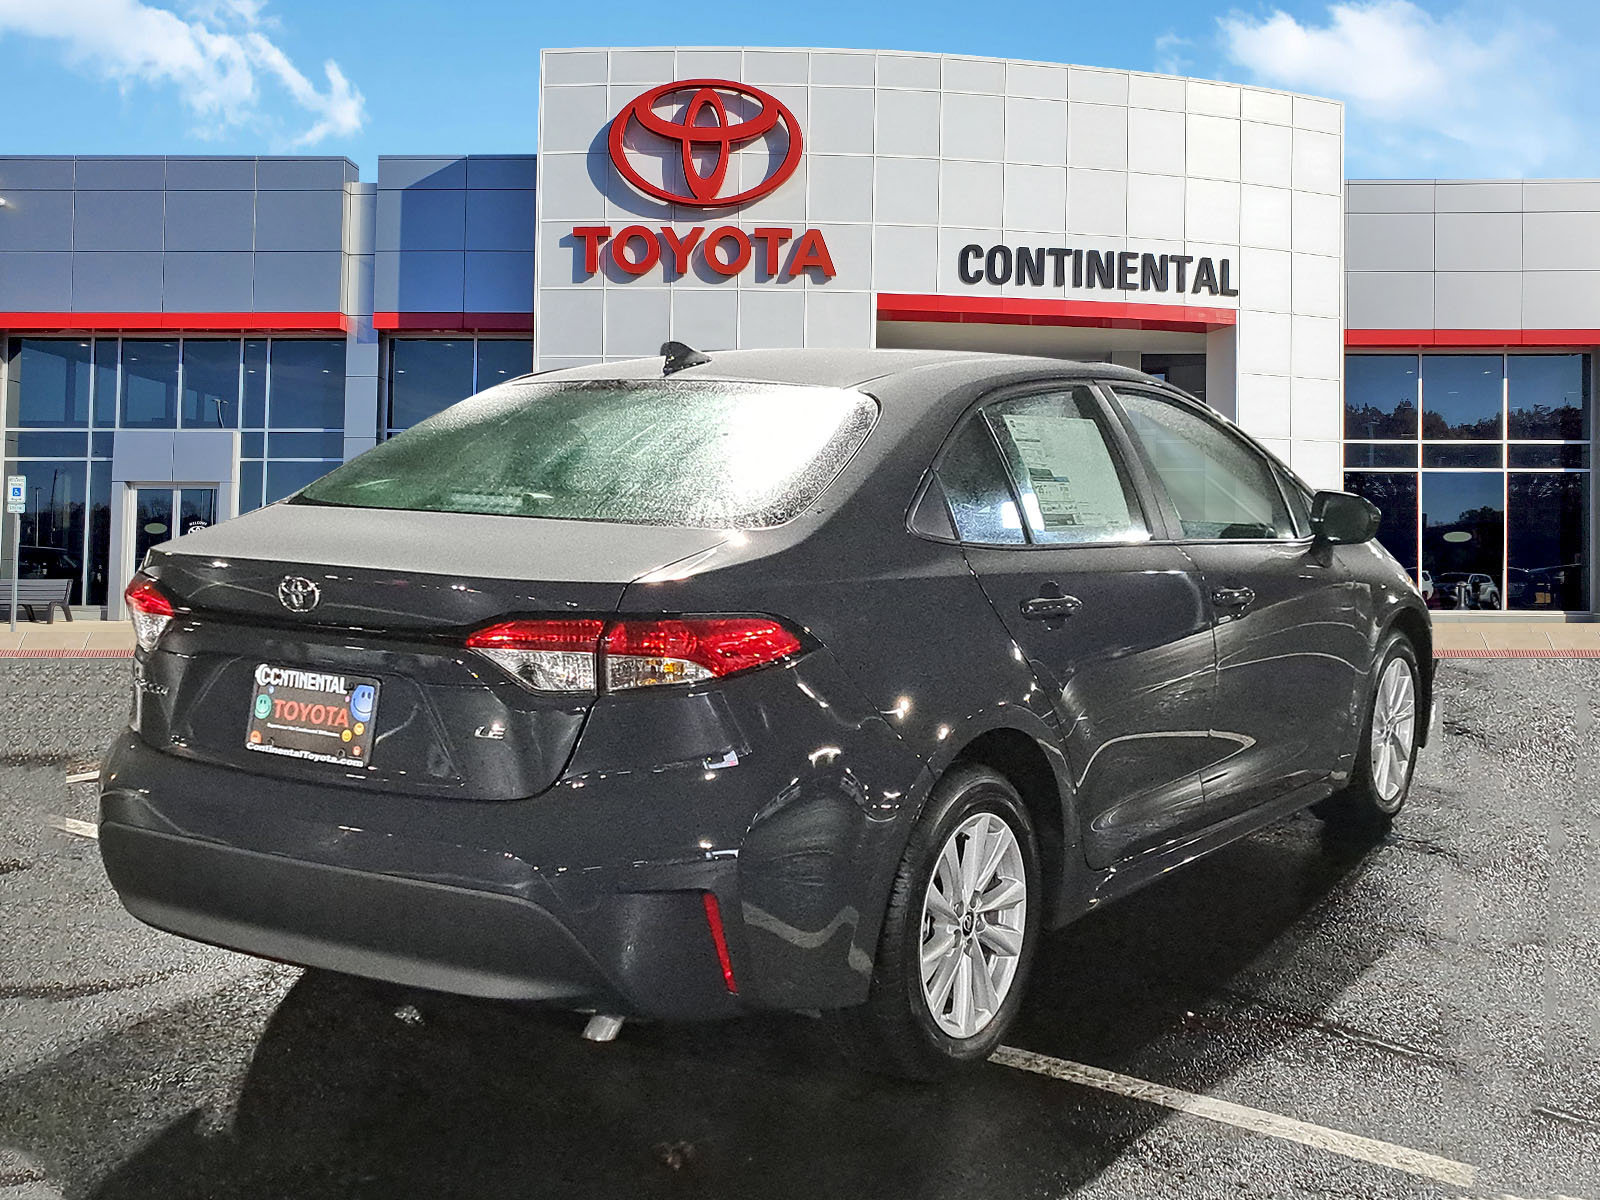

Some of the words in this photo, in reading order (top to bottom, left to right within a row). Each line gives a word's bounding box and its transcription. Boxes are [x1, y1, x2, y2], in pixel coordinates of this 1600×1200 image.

[572, 225, 837, 277] TOYOTA
[958, 244, 1239, 297] CONTINENTAL
[273, 699, 349, 728] TOYOTA
[474, 723, 506, 740] LE
[245, 742, 364, 767] ContinentalToyota.com
